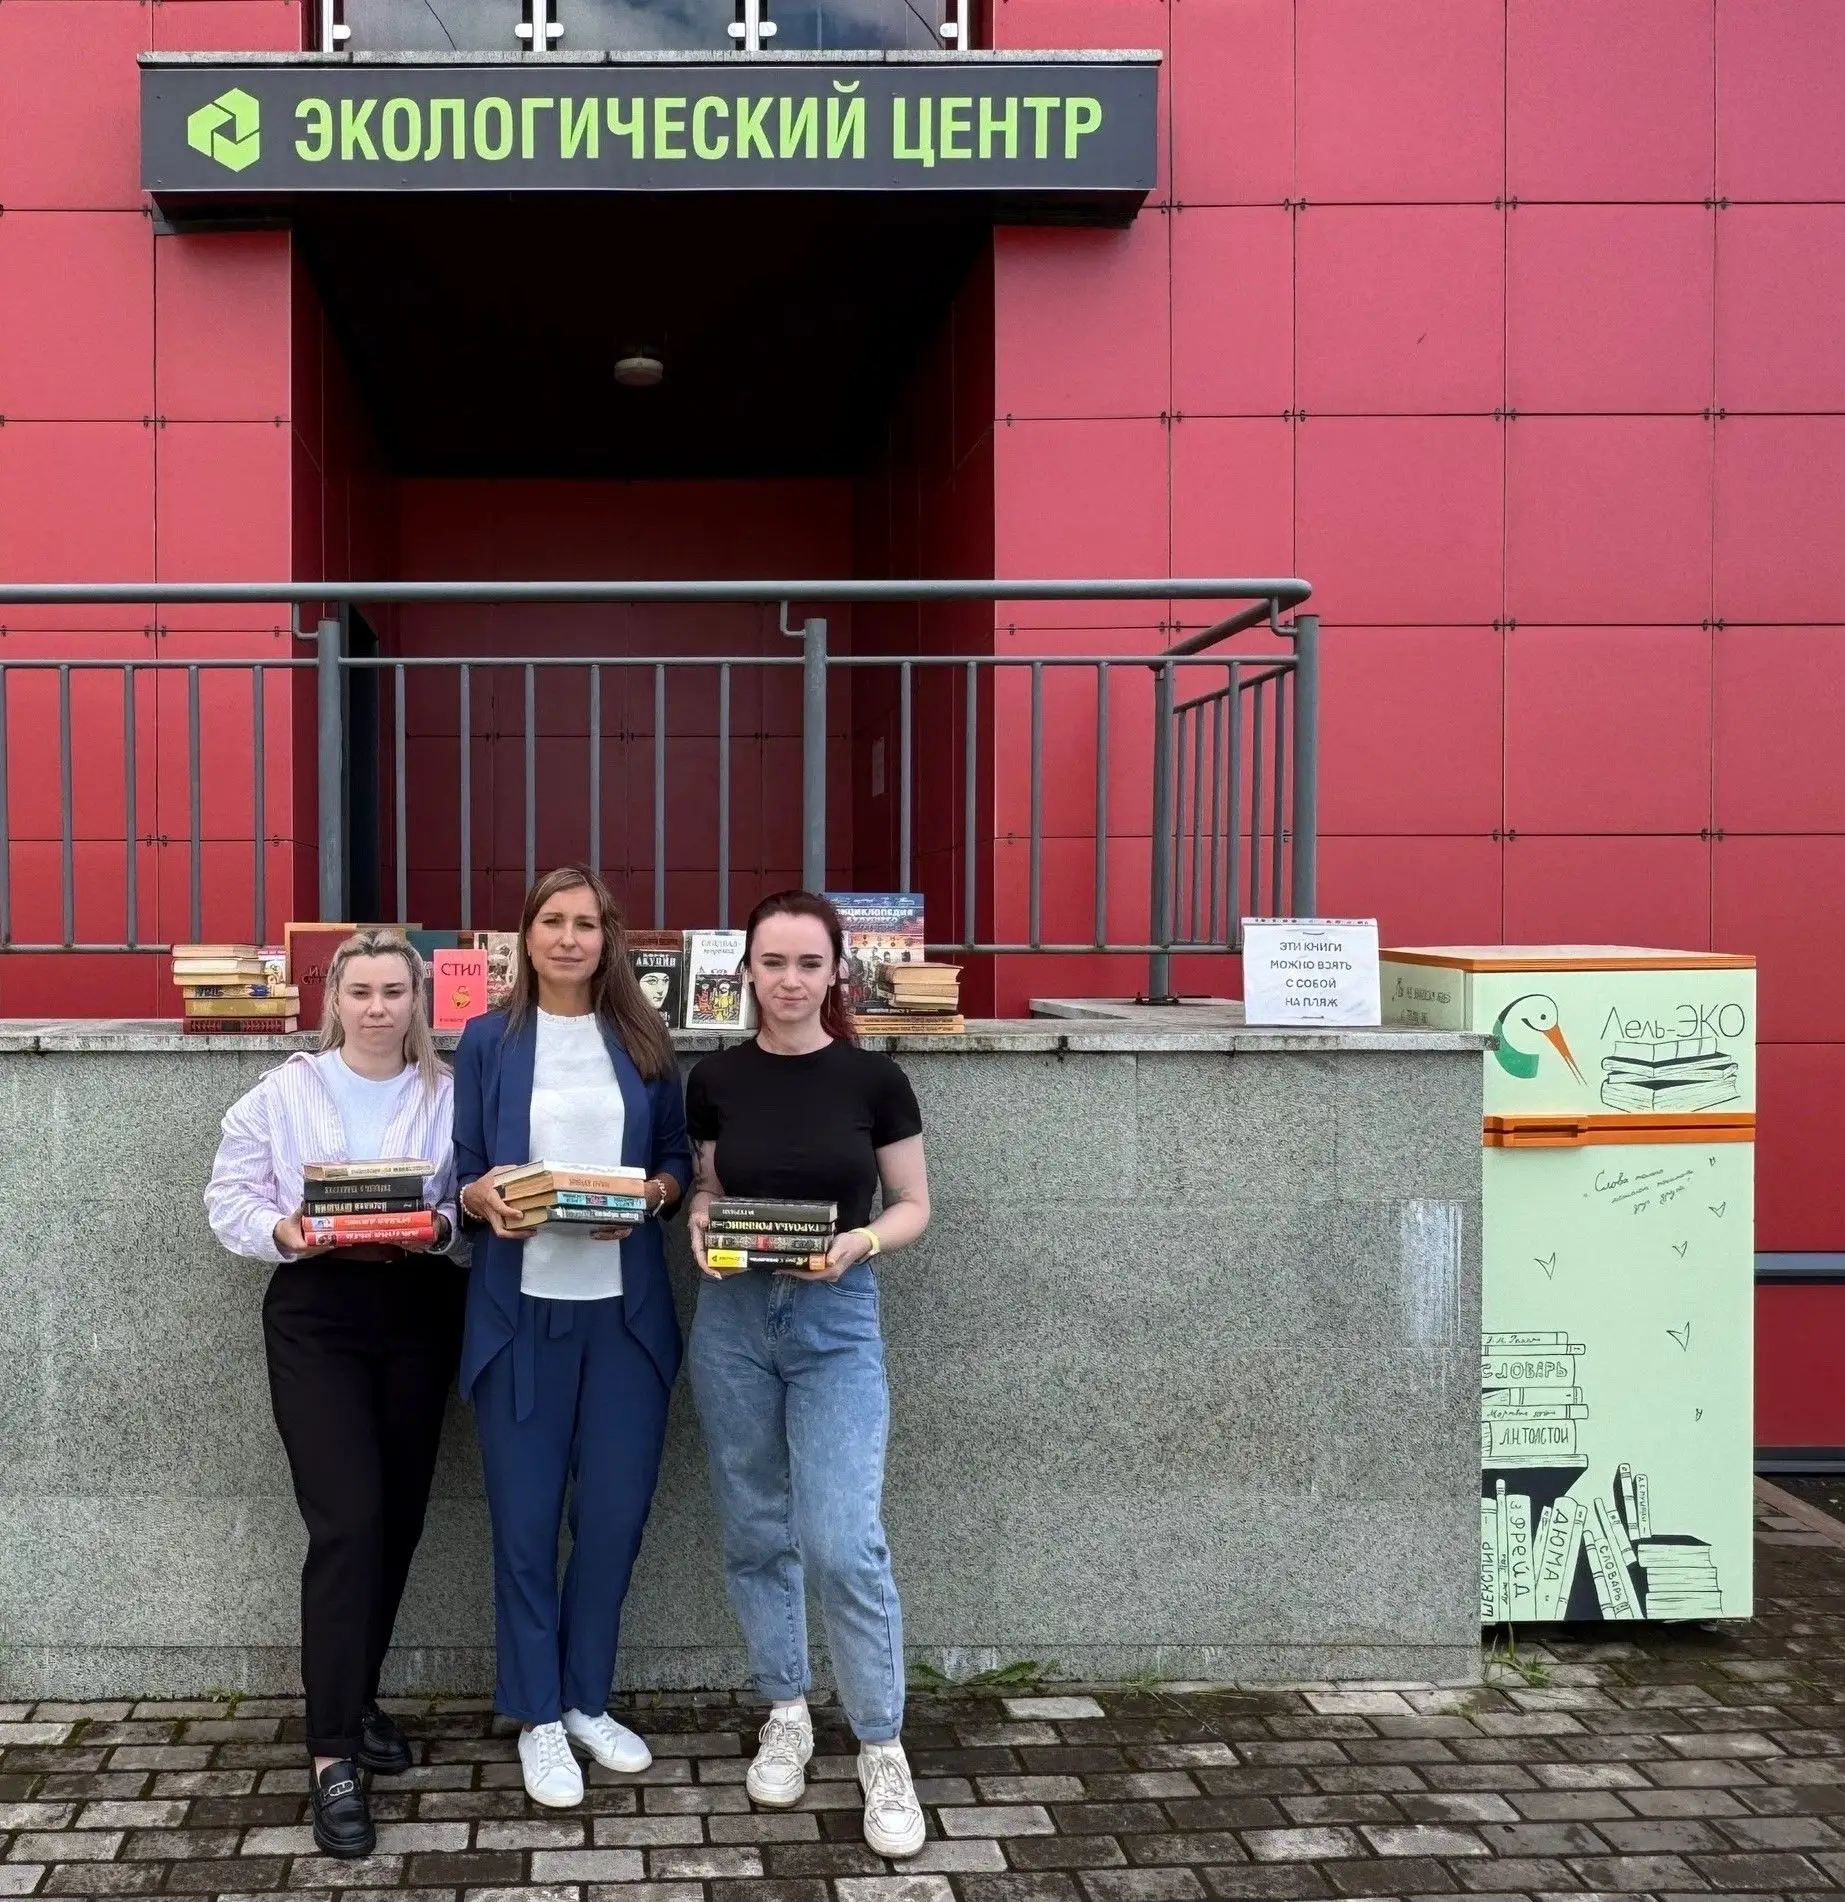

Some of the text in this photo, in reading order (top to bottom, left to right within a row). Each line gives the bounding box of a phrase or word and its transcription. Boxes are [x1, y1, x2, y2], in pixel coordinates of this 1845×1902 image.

[294, 80, 1104, 169] ЭКОЛОГИЧЕСКИЙ ЦЕНТР
[1279, 941, 1342, 952] ЭТИ КНИГИ
[1270, 960, 1352, 971] МОЖНО ВЗЯТЬ
[1286, 976, 1337, 989] С СОБОЙ
[1285, 997, 1339, 1008] НА ПЛЯЖ
[1600, 1003, 1746, 1040] Лель-ЭКО
[1481, 1361, 1568, 1379] СЛОВАРЬ
[1543, 1508, 1569, 1581] ДЮМА
[1480, 1541, 1494, 1618] ШЕКСПИР
[1599, 1545, 1622, 1601] СЛОВАРЬ
